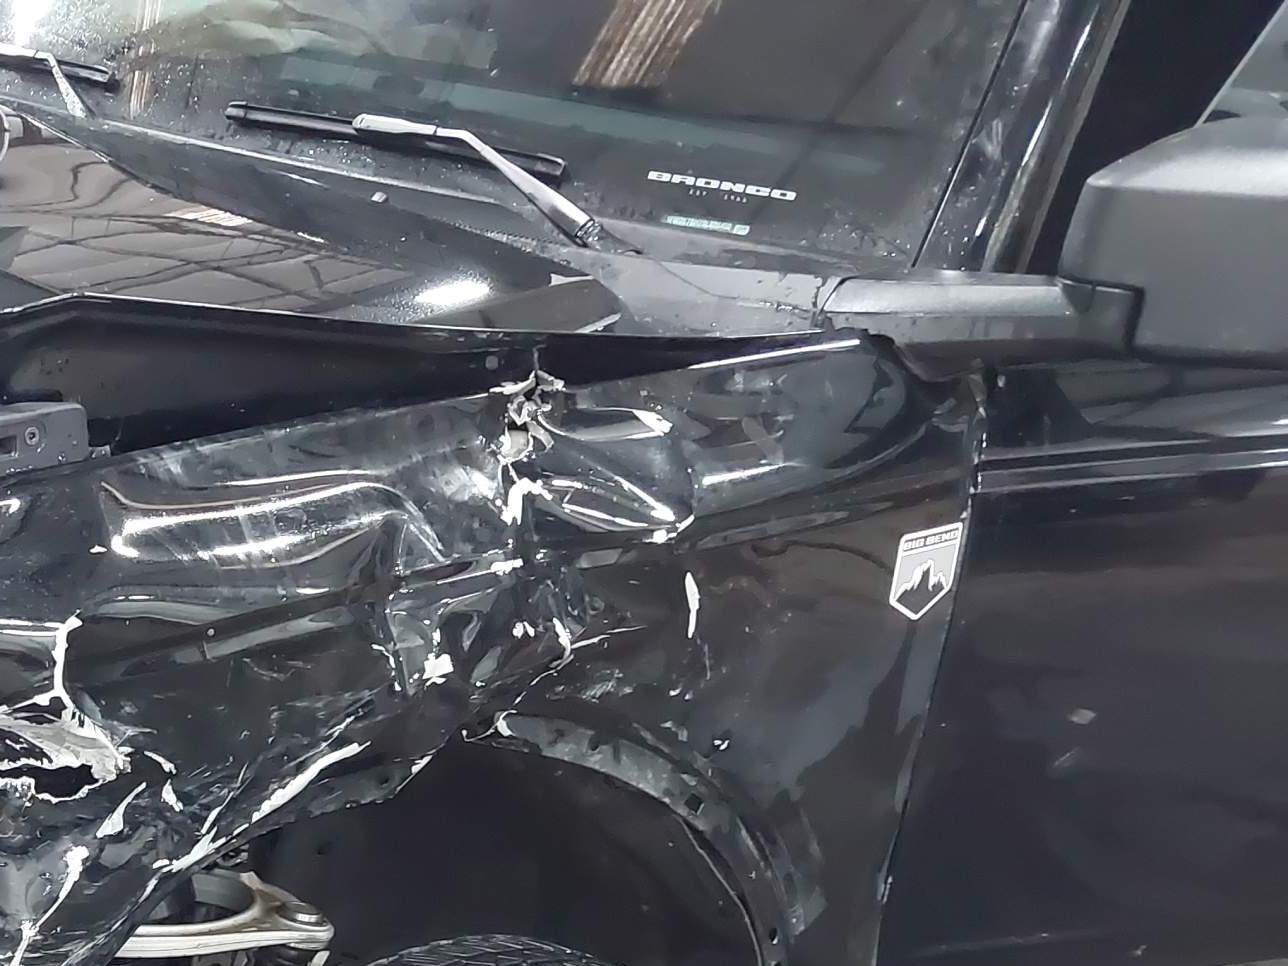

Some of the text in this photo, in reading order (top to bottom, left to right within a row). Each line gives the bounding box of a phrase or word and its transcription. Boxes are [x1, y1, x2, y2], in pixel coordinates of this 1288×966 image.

[647, 170, 797, 201] BRONCO
[903, 529, 959, 551] BIG BEND
